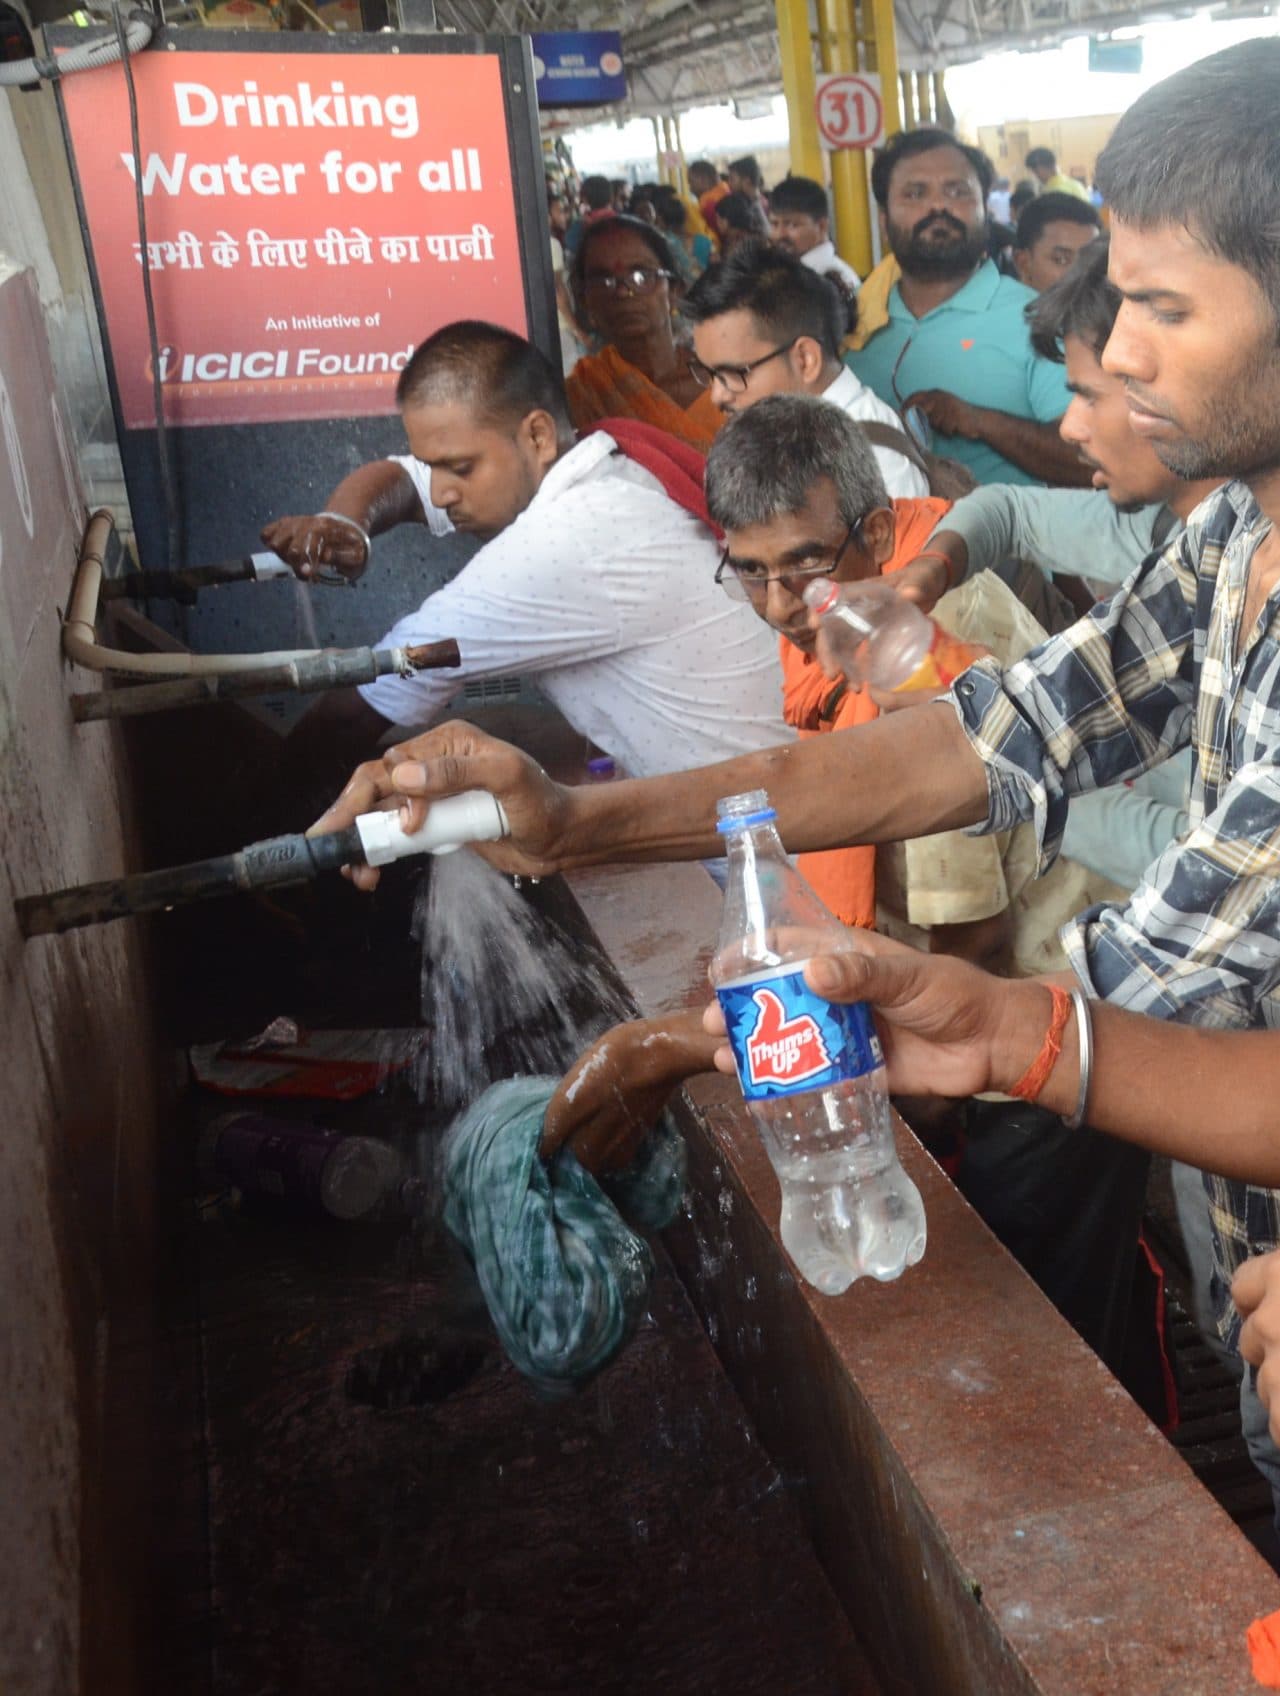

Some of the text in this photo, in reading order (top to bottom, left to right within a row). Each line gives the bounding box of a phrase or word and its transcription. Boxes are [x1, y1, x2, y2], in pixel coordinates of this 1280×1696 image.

[173, 81, 420, 138] Drinking
[826, 91, 867, 136] 31
[120, 148, 483, 196] Water for all
[133, 223, 495, 270] सभी के लिए पीने का पानी
[265, 312, 381, 332] An Initiative of
[181, 350, 289, 382] ICICI
[752, 1027, 814, 1068] Thums
